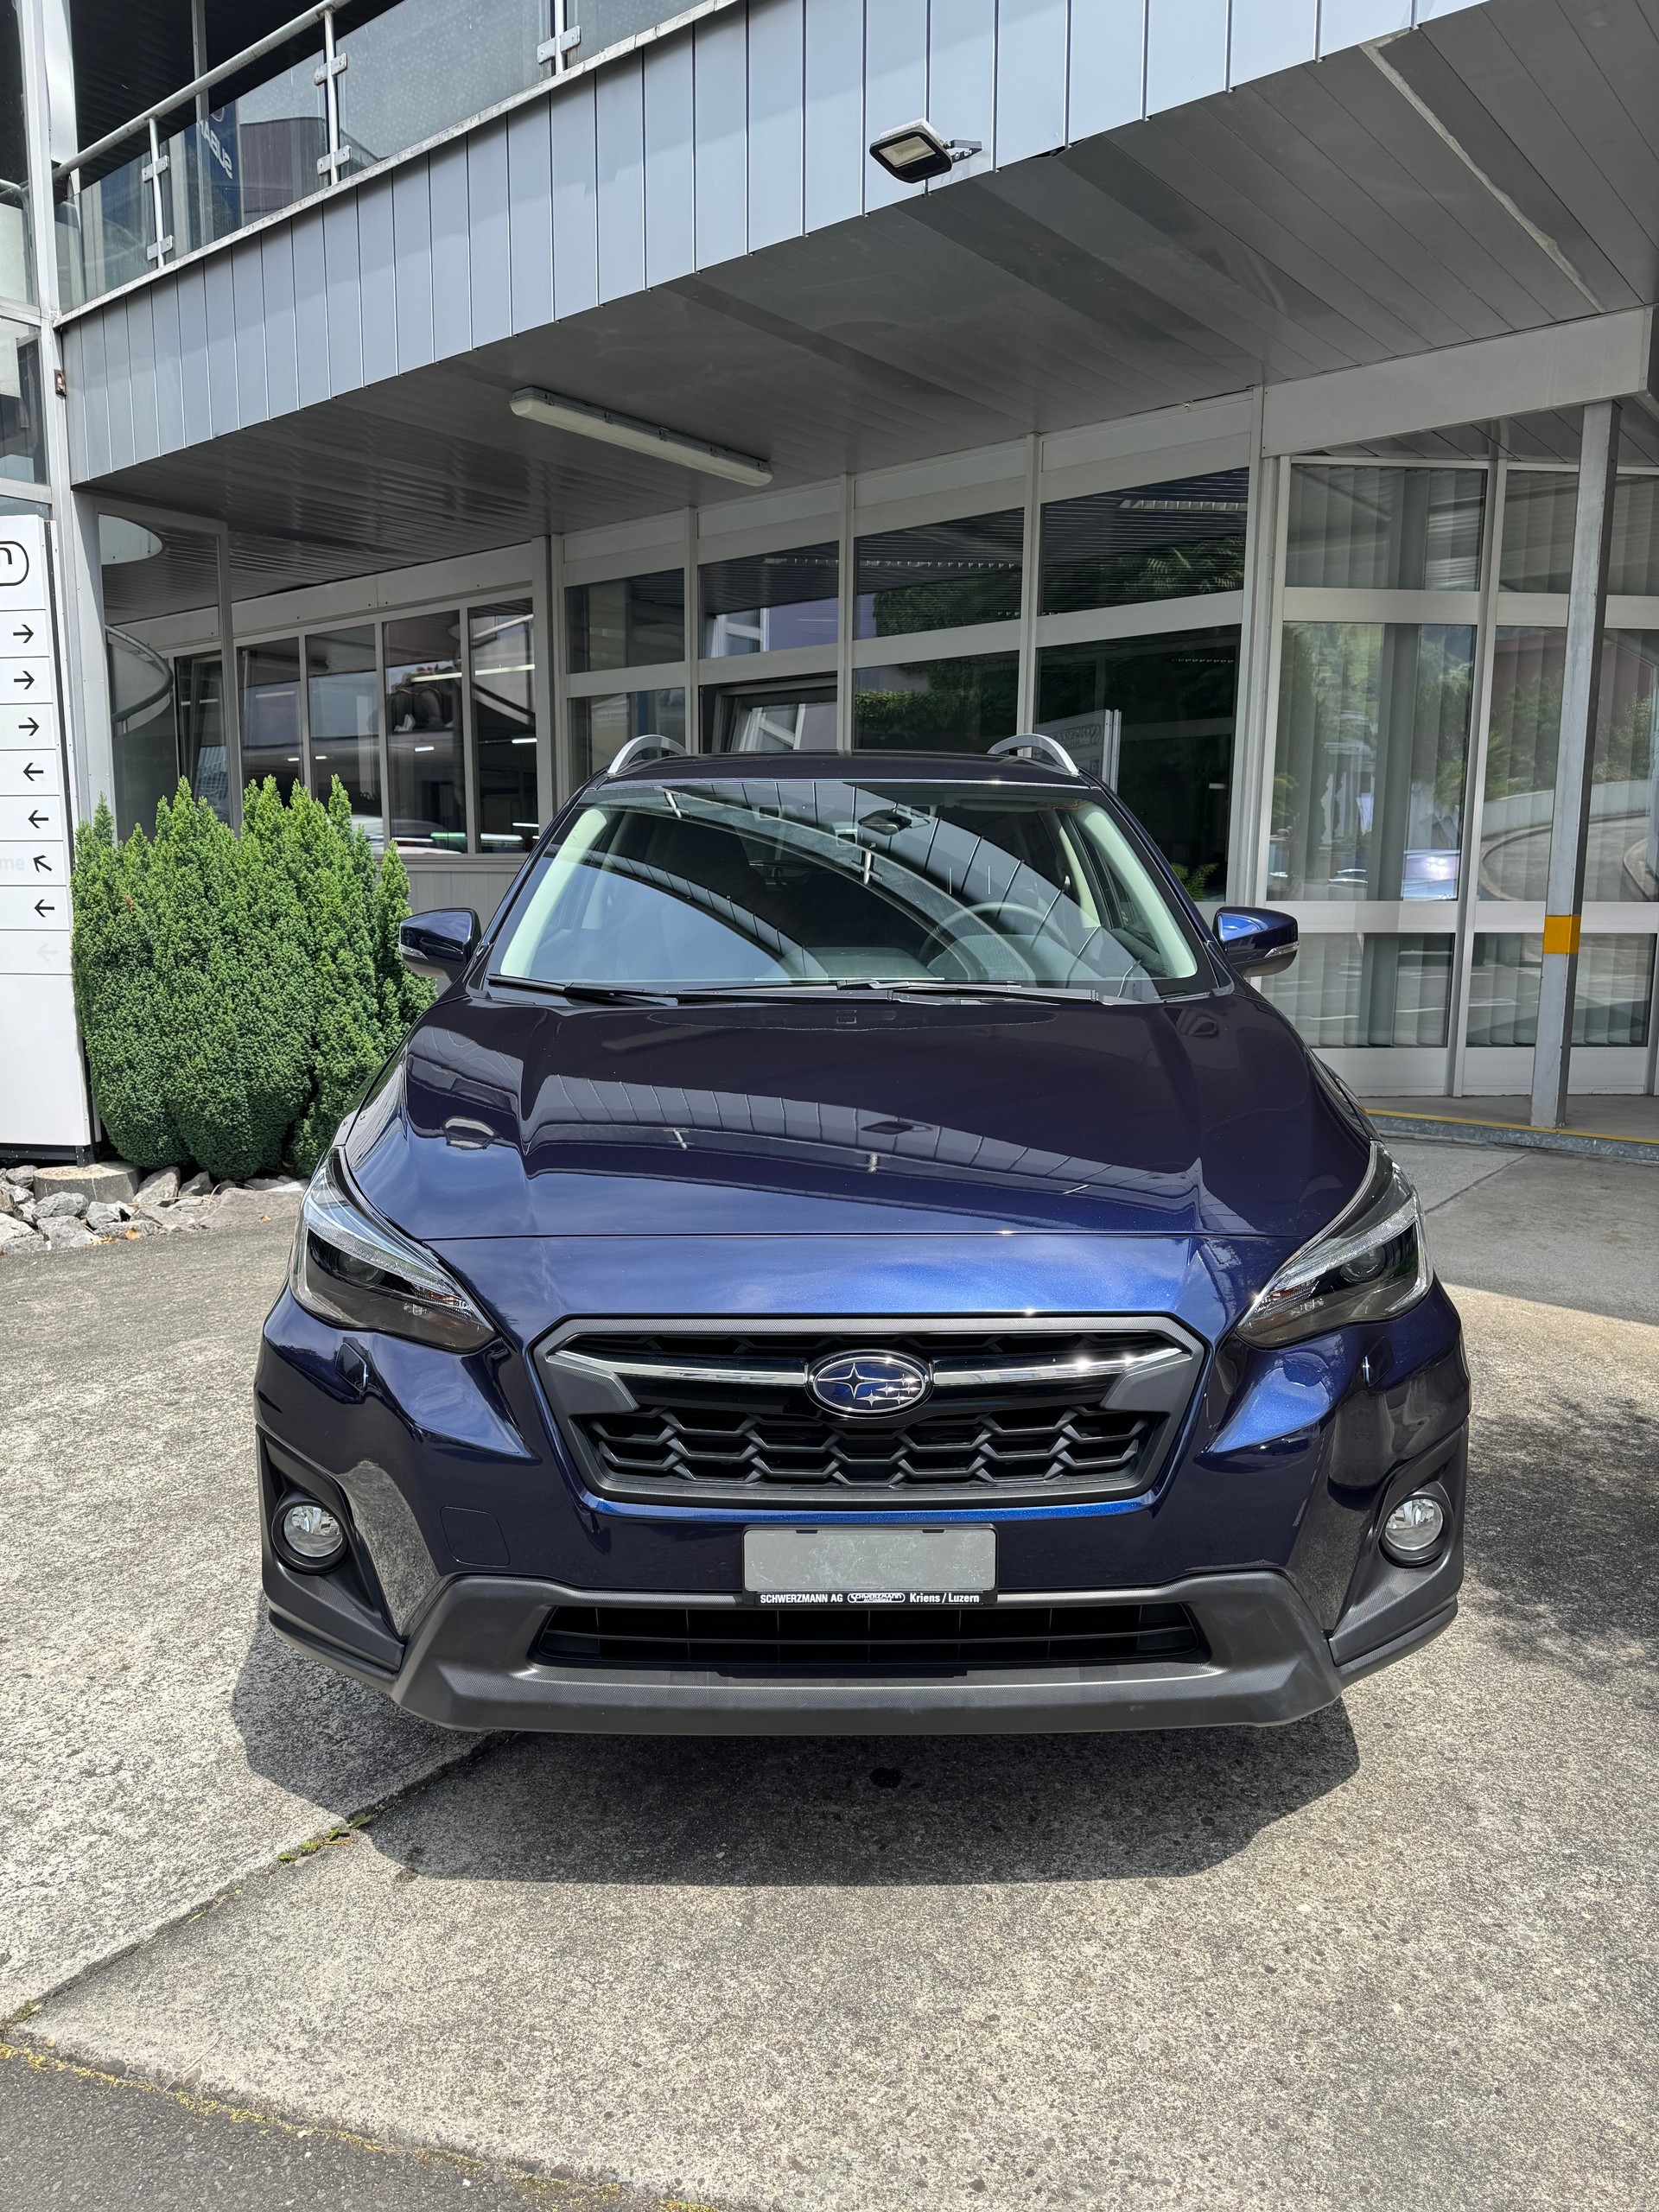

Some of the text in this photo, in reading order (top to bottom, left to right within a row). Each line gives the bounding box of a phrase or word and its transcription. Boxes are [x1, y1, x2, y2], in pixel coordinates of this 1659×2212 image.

[760, 1593, 828, 1604] SCHWERZMANN
[830, 1593, 843, 1603] AG
[910, 1592, 940, 1603] Kriens
[942, 1592, 947, 1604] /
[948, 1592, 979, 1603] Luzern
